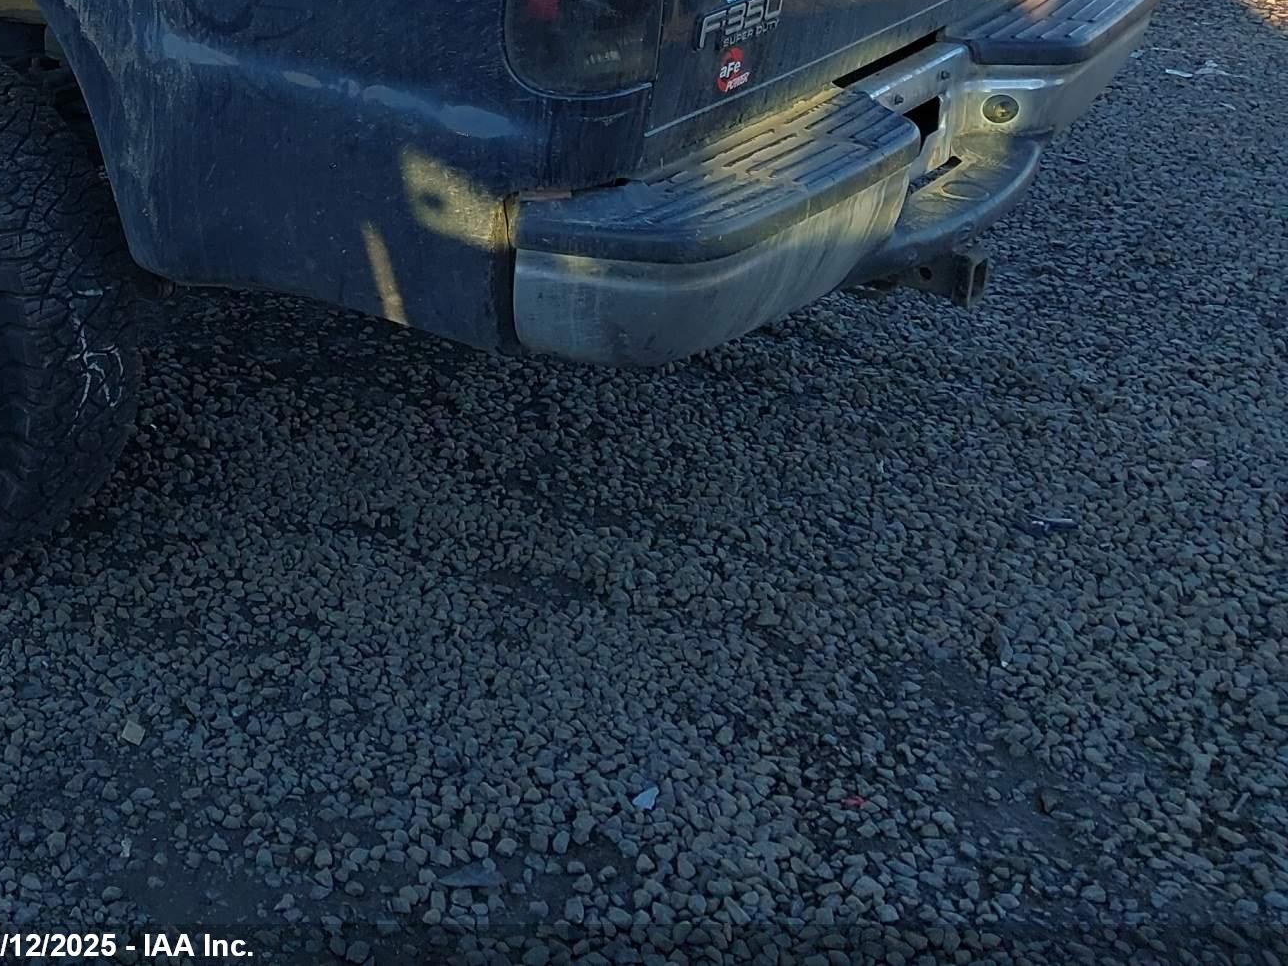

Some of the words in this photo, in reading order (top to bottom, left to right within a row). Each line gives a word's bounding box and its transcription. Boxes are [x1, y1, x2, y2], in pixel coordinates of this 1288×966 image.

[723, 30, 754, 48] SUPER
[755, 19, 781, 38] DUTY
[719, 60, 742, 79] aFe
[725, 71, 751, 93] POWER
